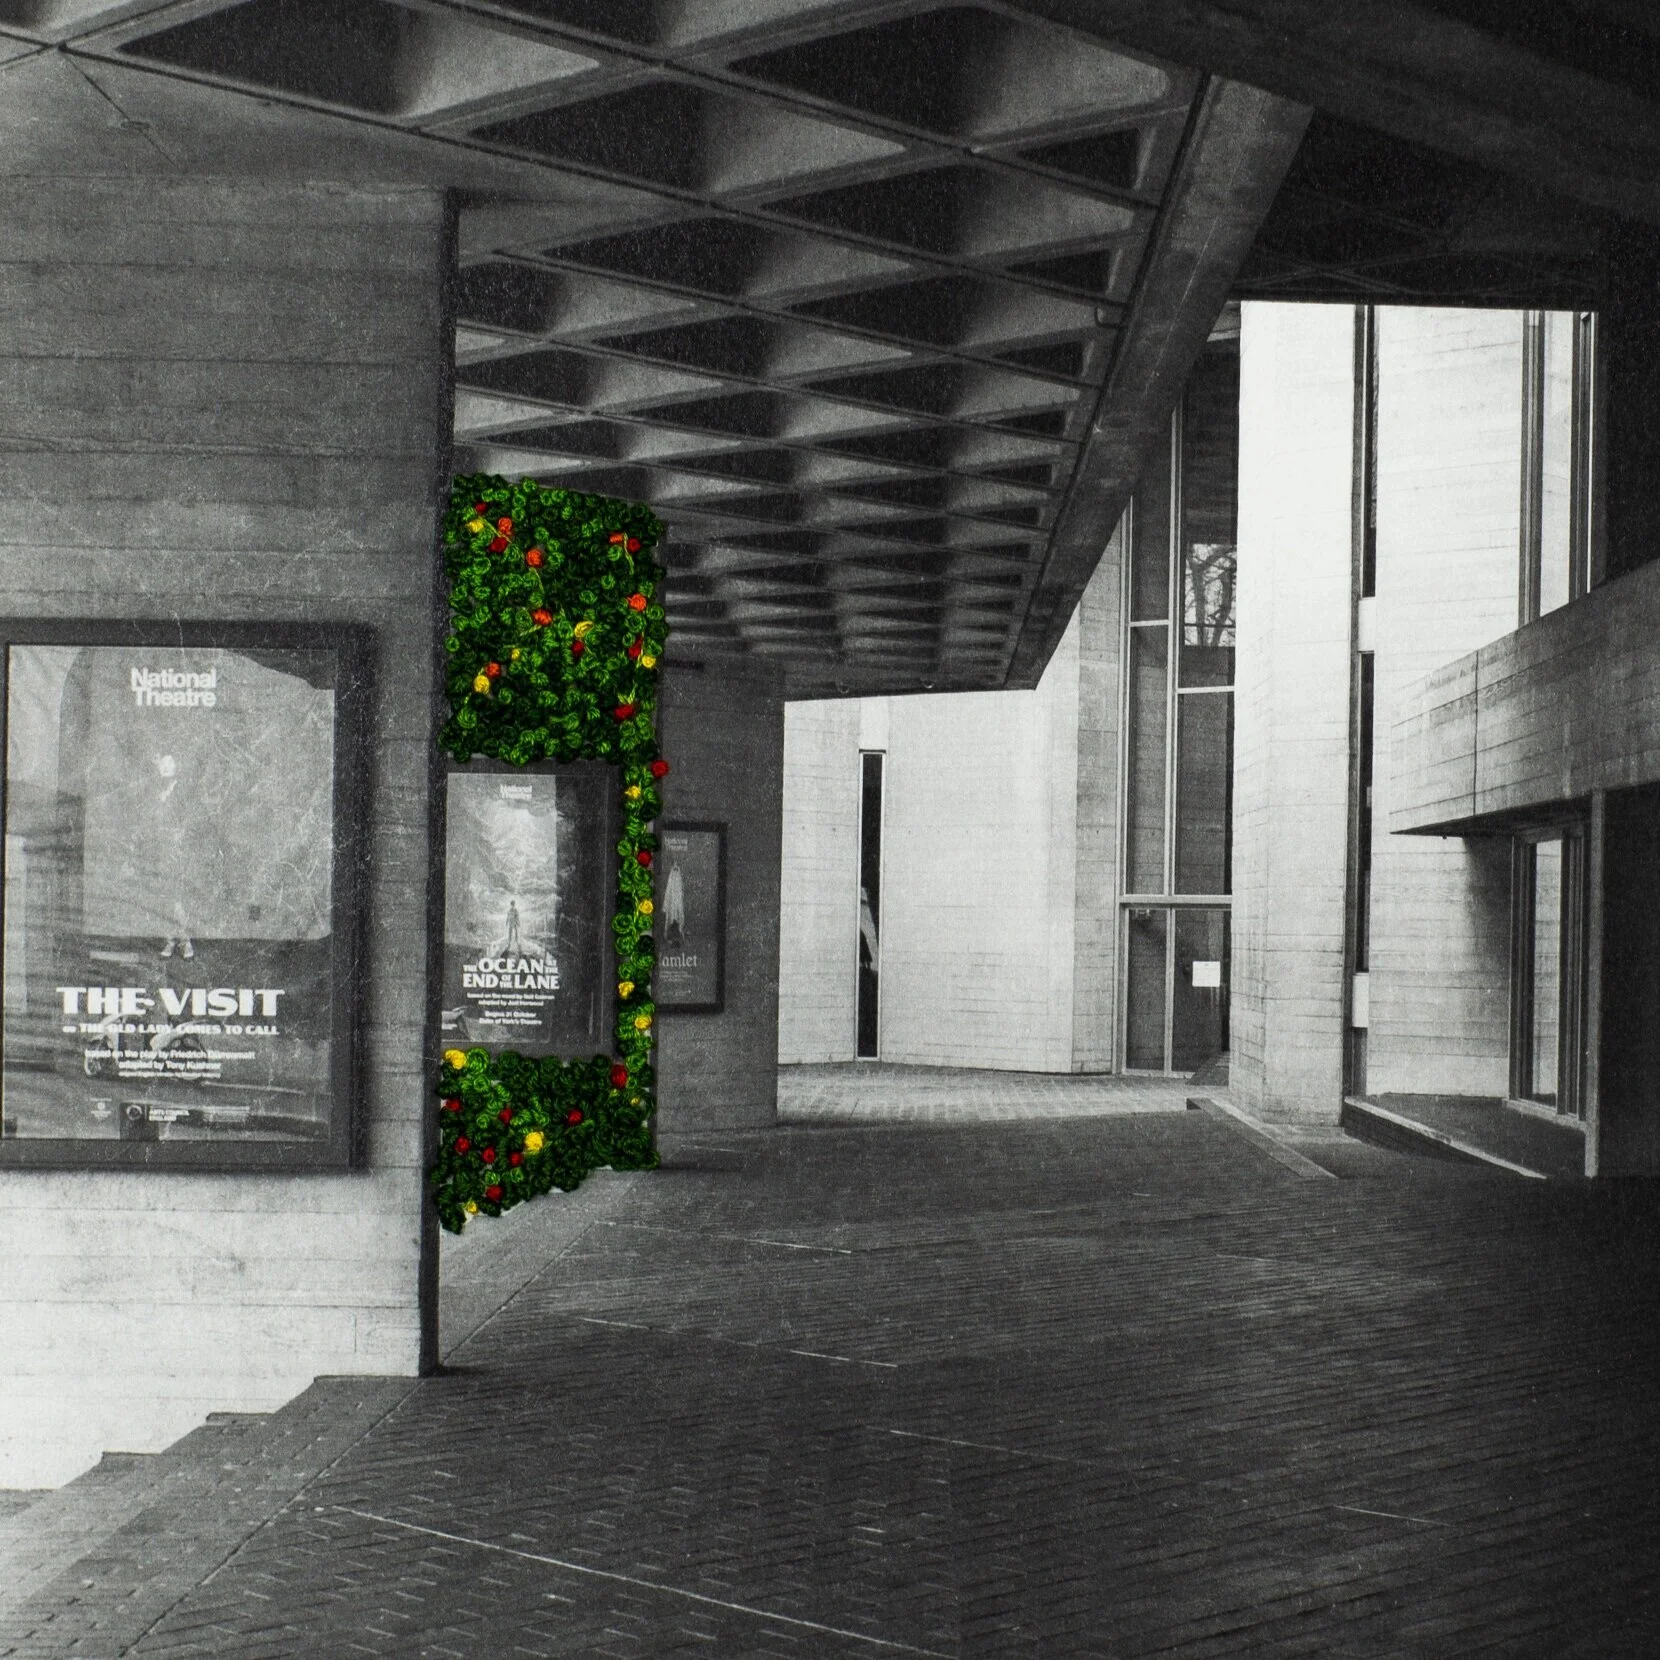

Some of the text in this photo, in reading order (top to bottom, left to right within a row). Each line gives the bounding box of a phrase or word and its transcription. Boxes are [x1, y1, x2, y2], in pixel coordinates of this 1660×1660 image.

[131, 667, 217, 691] National
[136, 687, 217, 707] Theatre
[478, 957, 544, 974] OCEAN
[659, 952, 697, 967] amlet
[462, 973, 499, 988] END
[514, 974, 560, 990] LANE
[56, 986, 286, 1017] THE VISIT
[175, 1023, 222, 1035] COMES
[224, 1024, 243, 1035] TO
[245, 1025, 281, 1036] CALL
